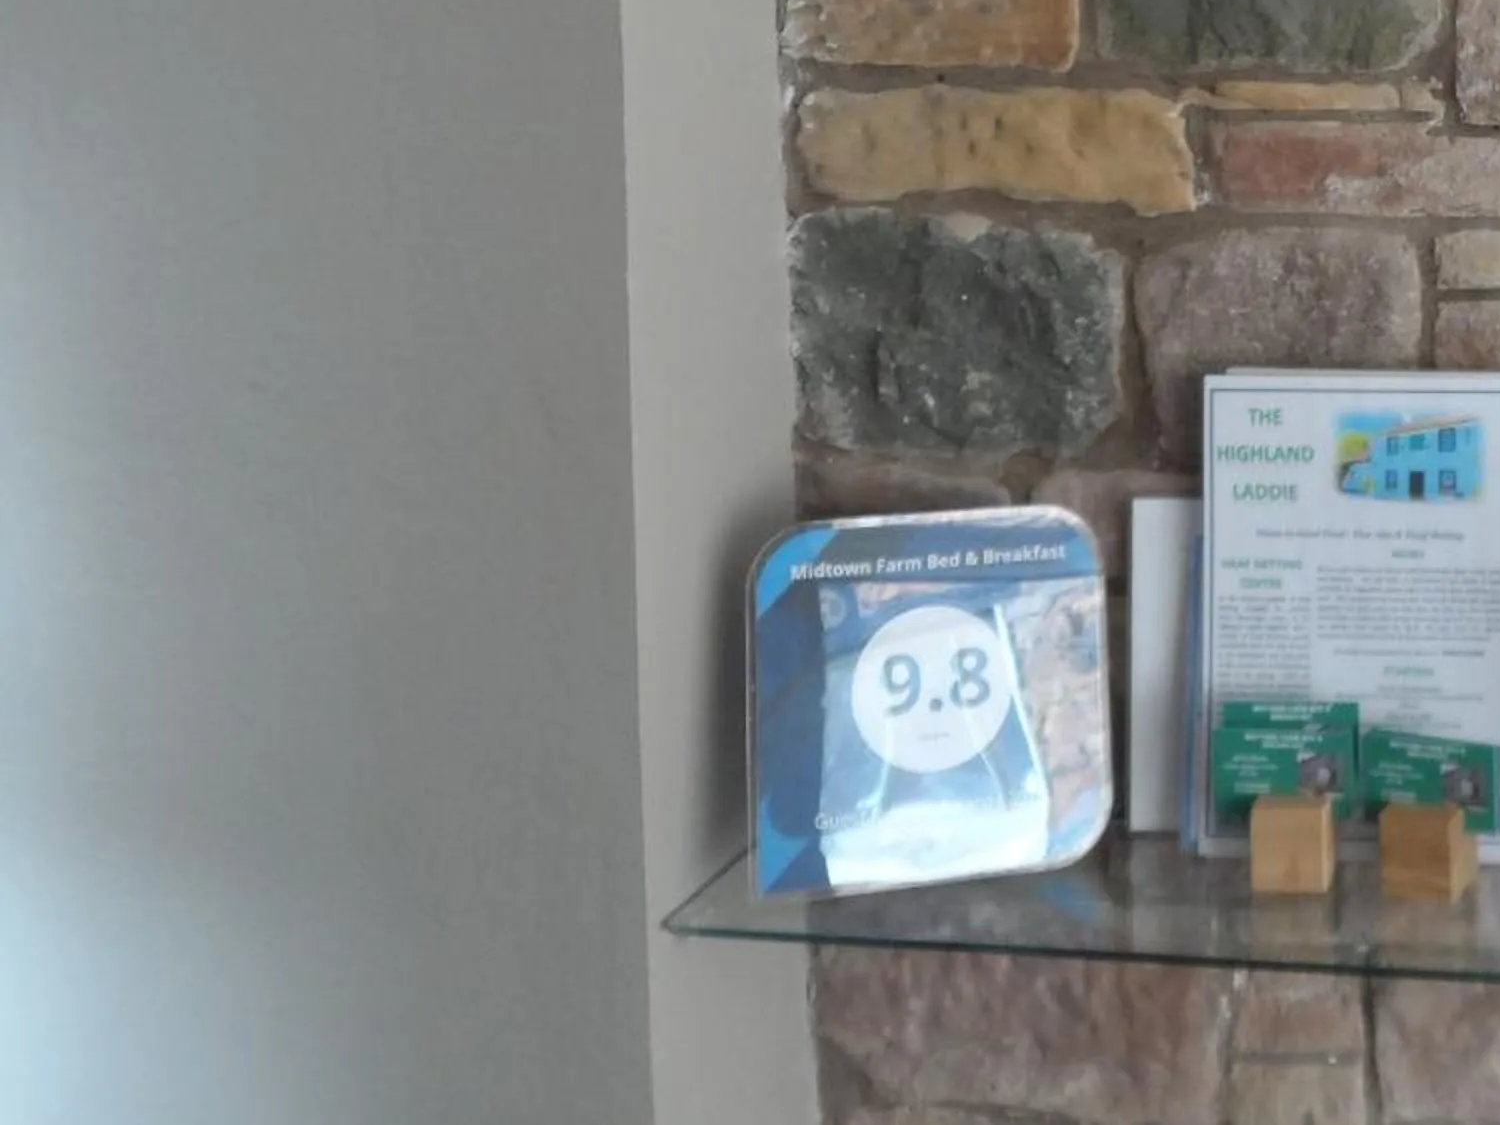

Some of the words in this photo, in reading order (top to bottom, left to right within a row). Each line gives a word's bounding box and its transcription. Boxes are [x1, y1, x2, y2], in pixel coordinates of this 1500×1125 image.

[1248, 408, 1284, 427] THE
[1216, 445, 1316, 463] HIGHLAND
[1232, 483, 1299, 503] LADDIE
[789, 558, 871, 580] Midtown
[876, 555, 922, 574] Farm
[927, 551, 959, 570] Bed
[965, 551, 979, 567] &
[983, 544, 1067, 565] Breakfast
[880, 646, 991, 718] 9.8
